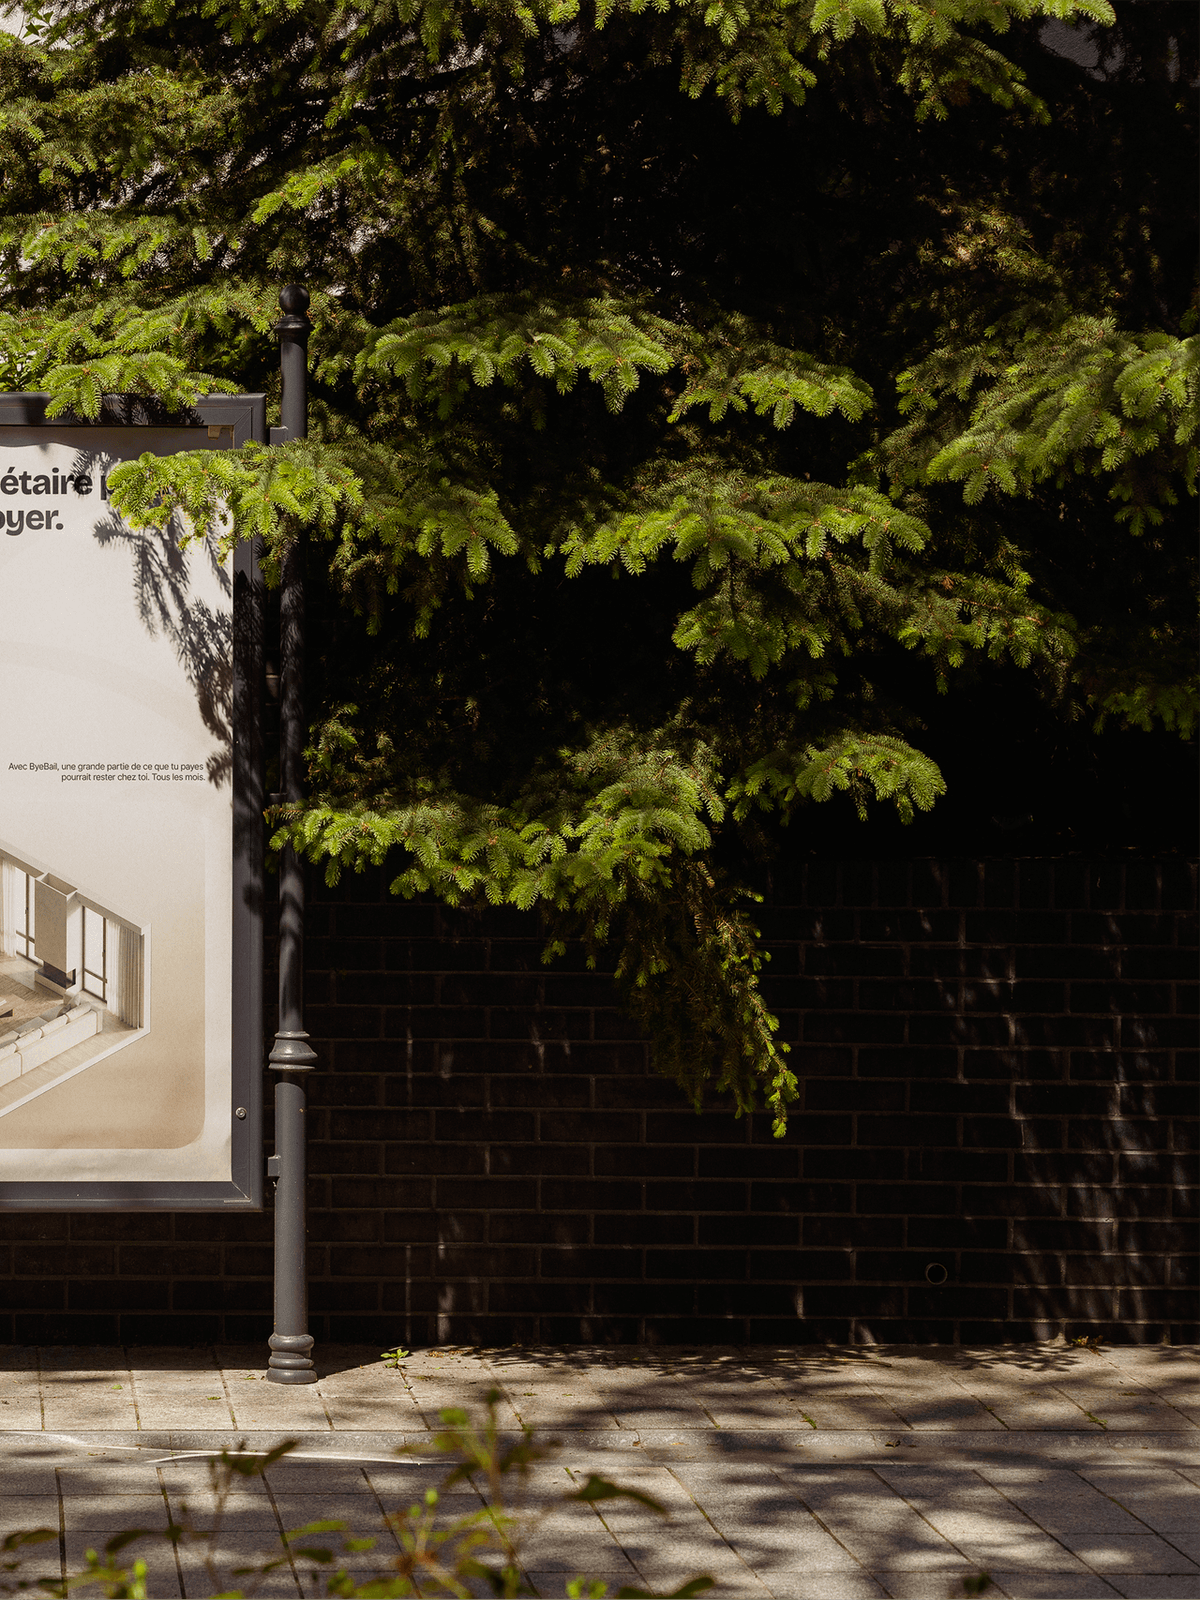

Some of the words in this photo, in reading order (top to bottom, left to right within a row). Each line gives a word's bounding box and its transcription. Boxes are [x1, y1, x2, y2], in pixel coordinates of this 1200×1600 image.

[8, 762, 28, 771] Avec
[29, 762, 60, 772] ByeBail,
[61, 763, 76, 771] une
[77, 762, 106, 773] grande
[106, 762, 130, 773] partie
[131, 762, 142, 771] de
[142, 763, 153, 771] ce
[154, 763, 170, 773] que
[170, 763, 179, 771] tu
[180, 763, 204, 773] payes
[61, 772, 92, 783] pourrait
[92, 773, 116, 782] rester
[116, 772, 137, 782] chez
[137, 772, 150, 782] toi.
[151, 772, 171, 782] Tous
[171, 772, 184, 782] les
[184, 772, 206, 782] mois.
